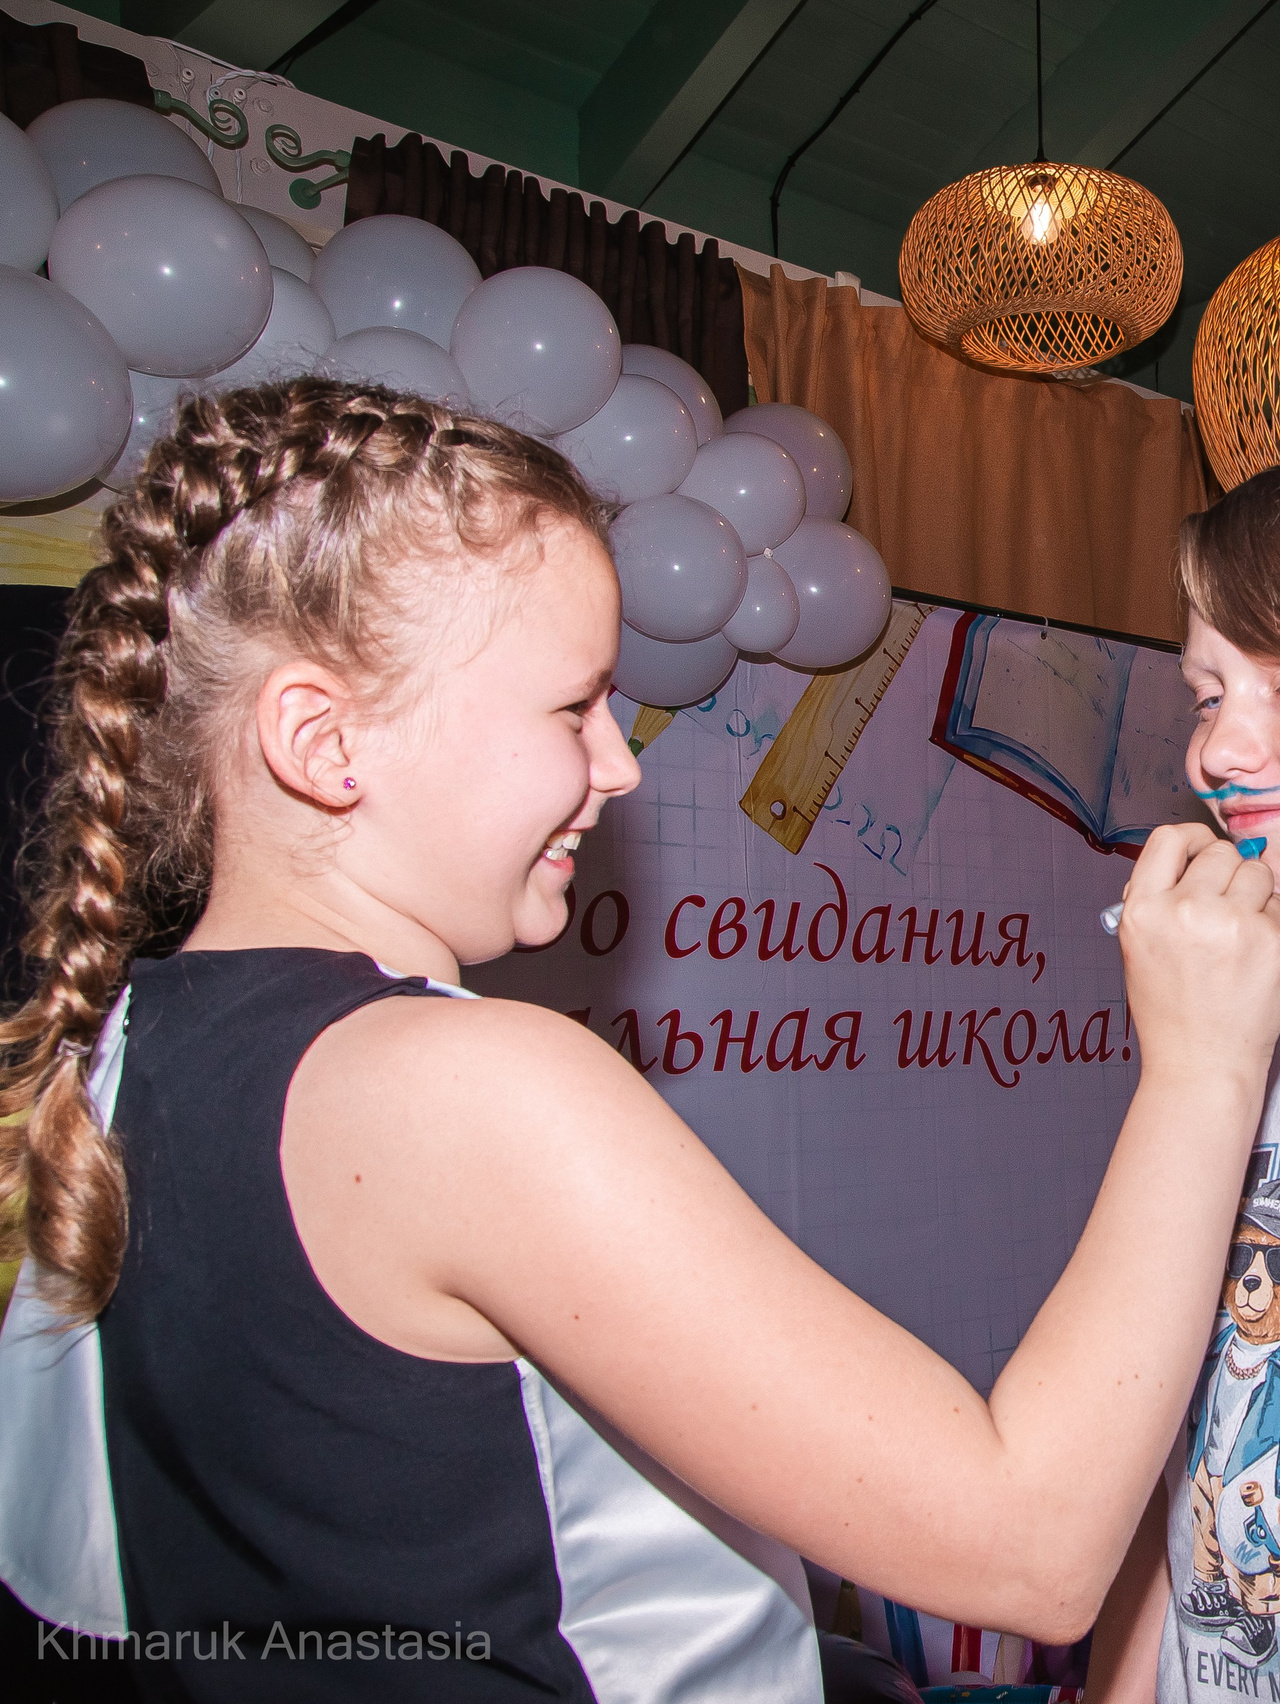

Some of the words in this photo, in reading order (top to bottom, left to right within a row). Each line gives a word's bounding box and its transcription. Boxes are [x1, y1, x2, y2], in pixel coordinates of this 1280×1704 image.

[664, 862, 1046, 984] свидания,
[563, 1006, 867, 1076] льная
[892, 1006, 1132, 1089] школа!
[1197, 1650, 1259, 1699] EVERY
